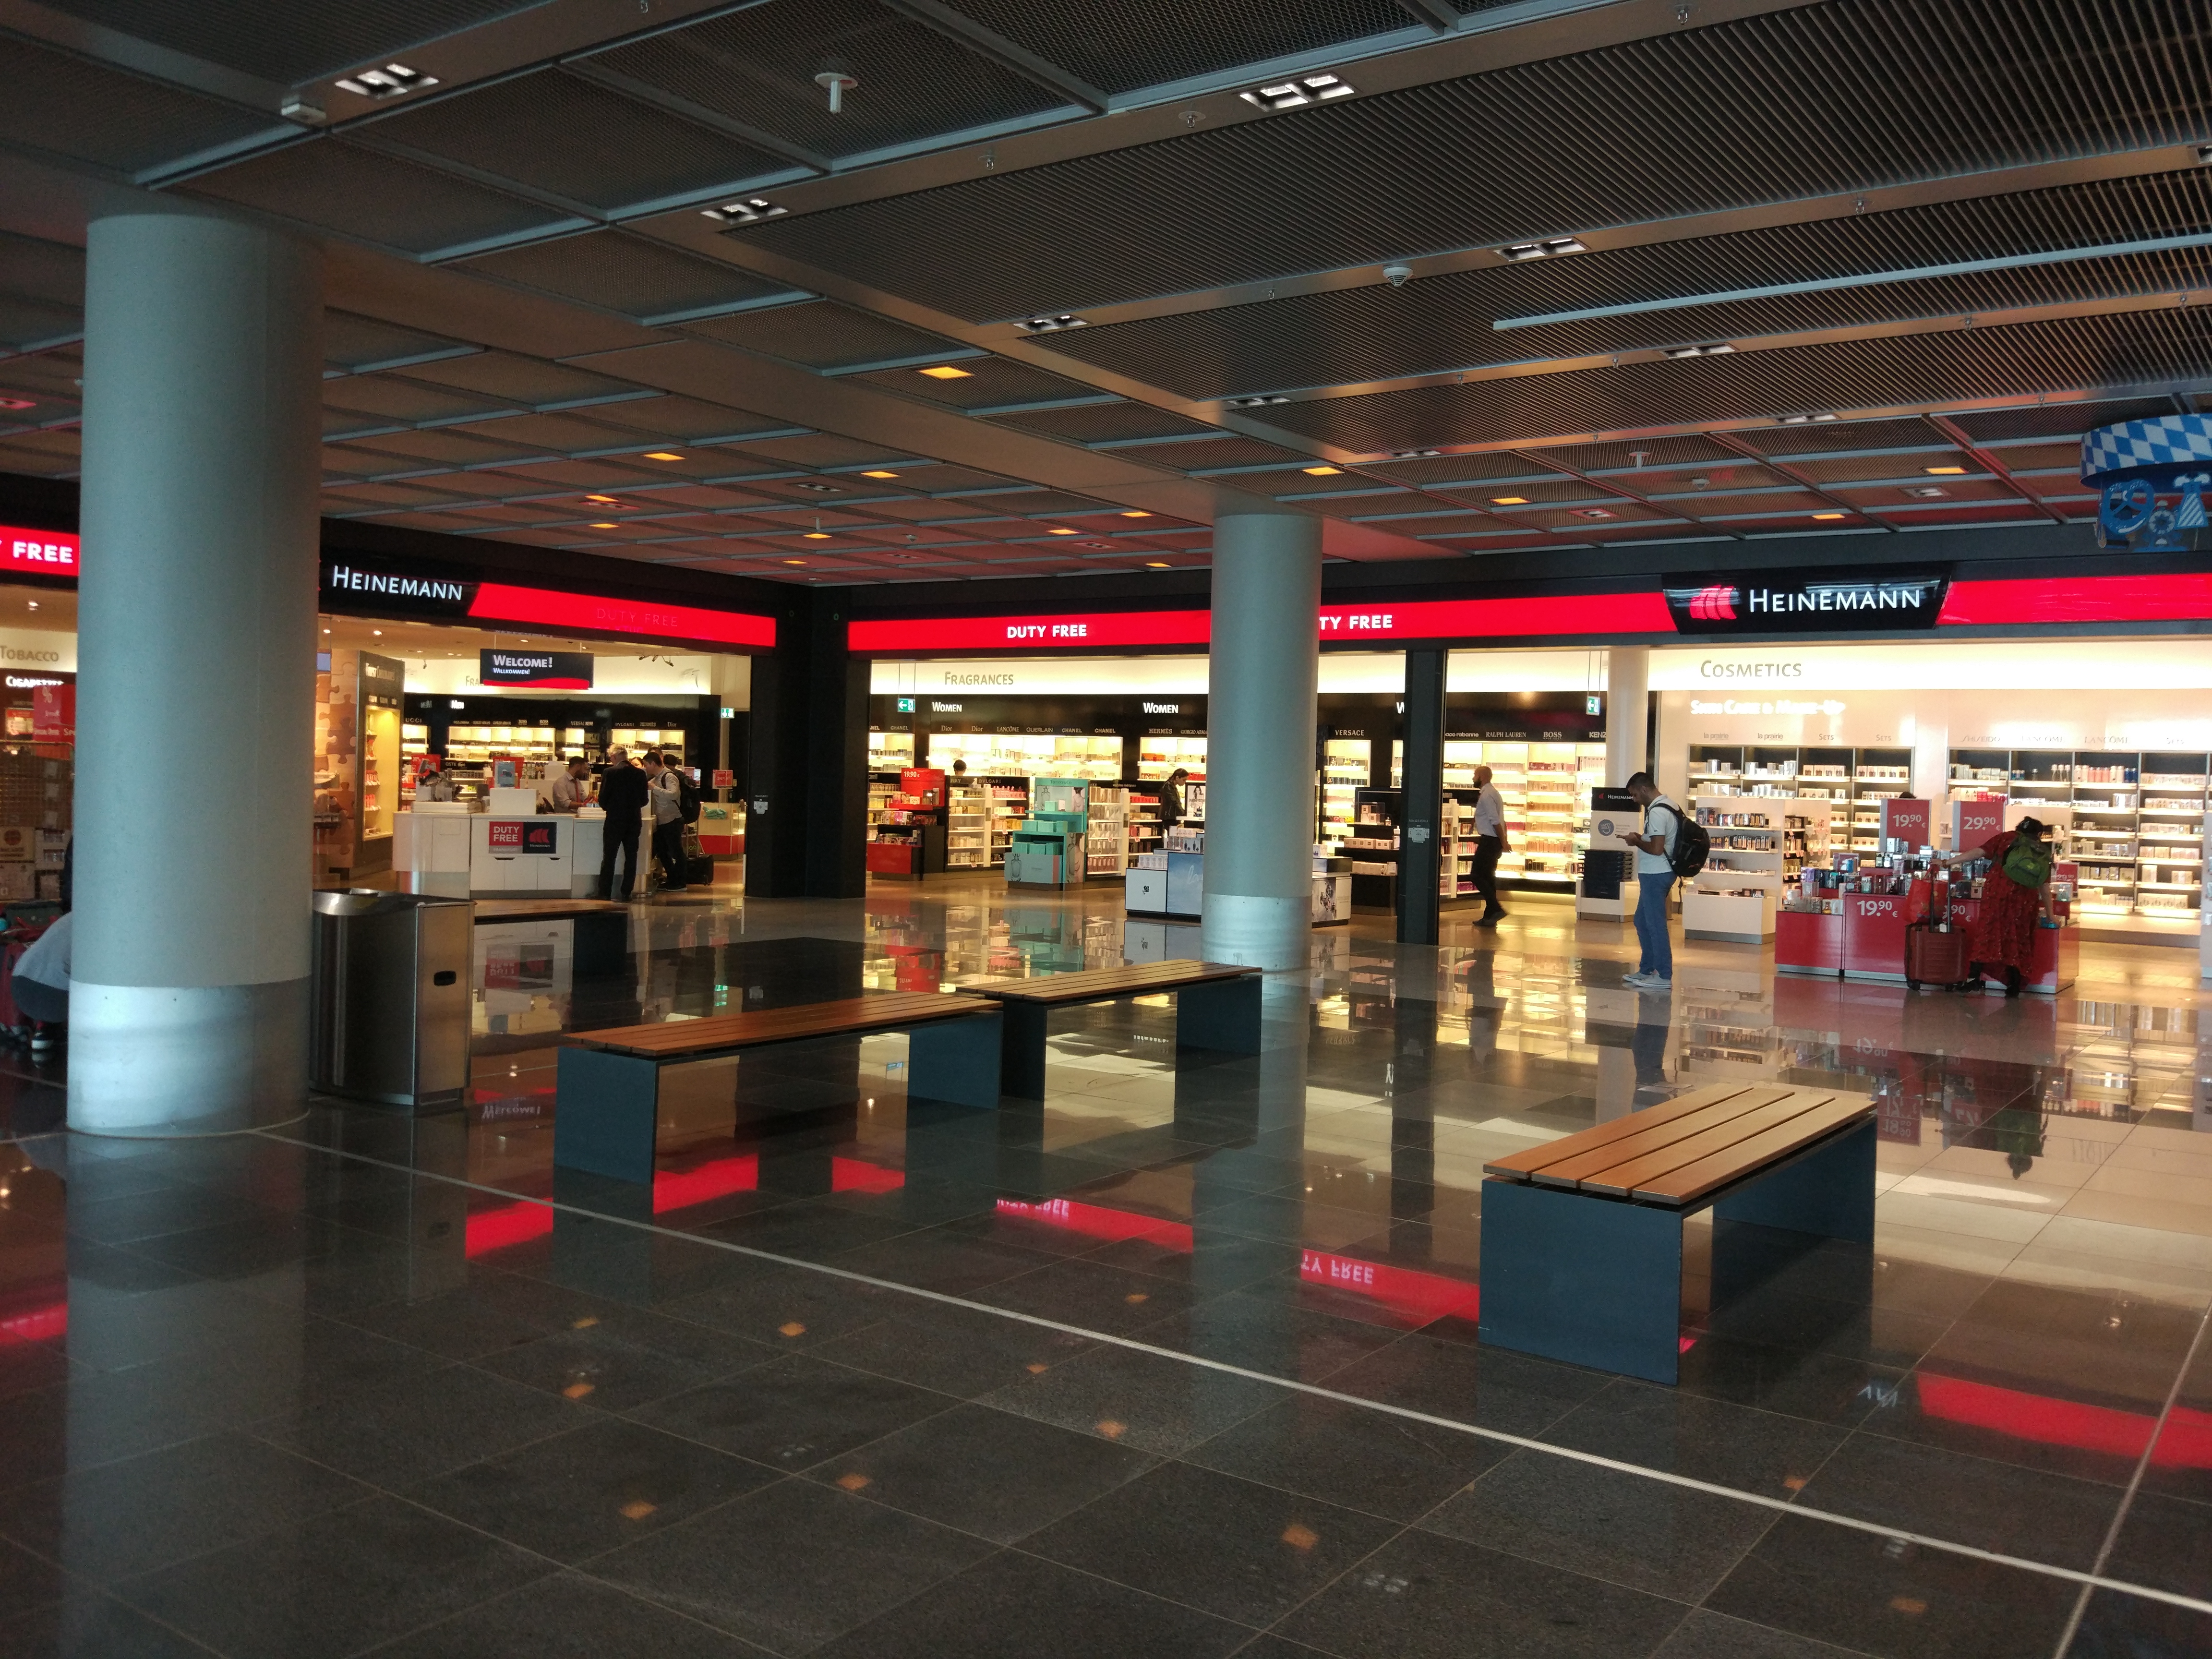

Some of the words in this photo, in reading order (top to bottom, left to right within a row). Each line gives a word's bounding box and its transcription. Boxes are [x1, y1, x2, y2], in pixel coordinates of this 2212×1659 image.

[13, 541, 73, 564] FREE
[332, 565, 462, 601] HEINEMANN
[1750, 589, 1921, 613] HEINEMANN
[597, 608, 637, 622] DUTY
[645, 613, 677, 627] FREE
[1319, 616, 1342, 630] TY
[1349, 615, 1393, 629] FREE
[1007, 625, 1046, 638] DUTY
[1052, 625, 1087, 637] FREE
[0, 645, 59, 662] TOBACCO
[493, 655, 553, 668] WELCOME!
[1701, 660, 1802, 677] COSMETICS
[466, 676, 485, 686] FRA
[945, 671, 1014, 685] FRAGRANCES
[451, 700, 465, 709] MEN
[932, 702, 962, 712] WOMEN
[1143, 702, 1179, 713] WOMEN
[1892, 814, 1922, 828] 19.90
[1963, 817, 1996, 830] 29.90
[1856, 900, 1893, 917] 19.90
